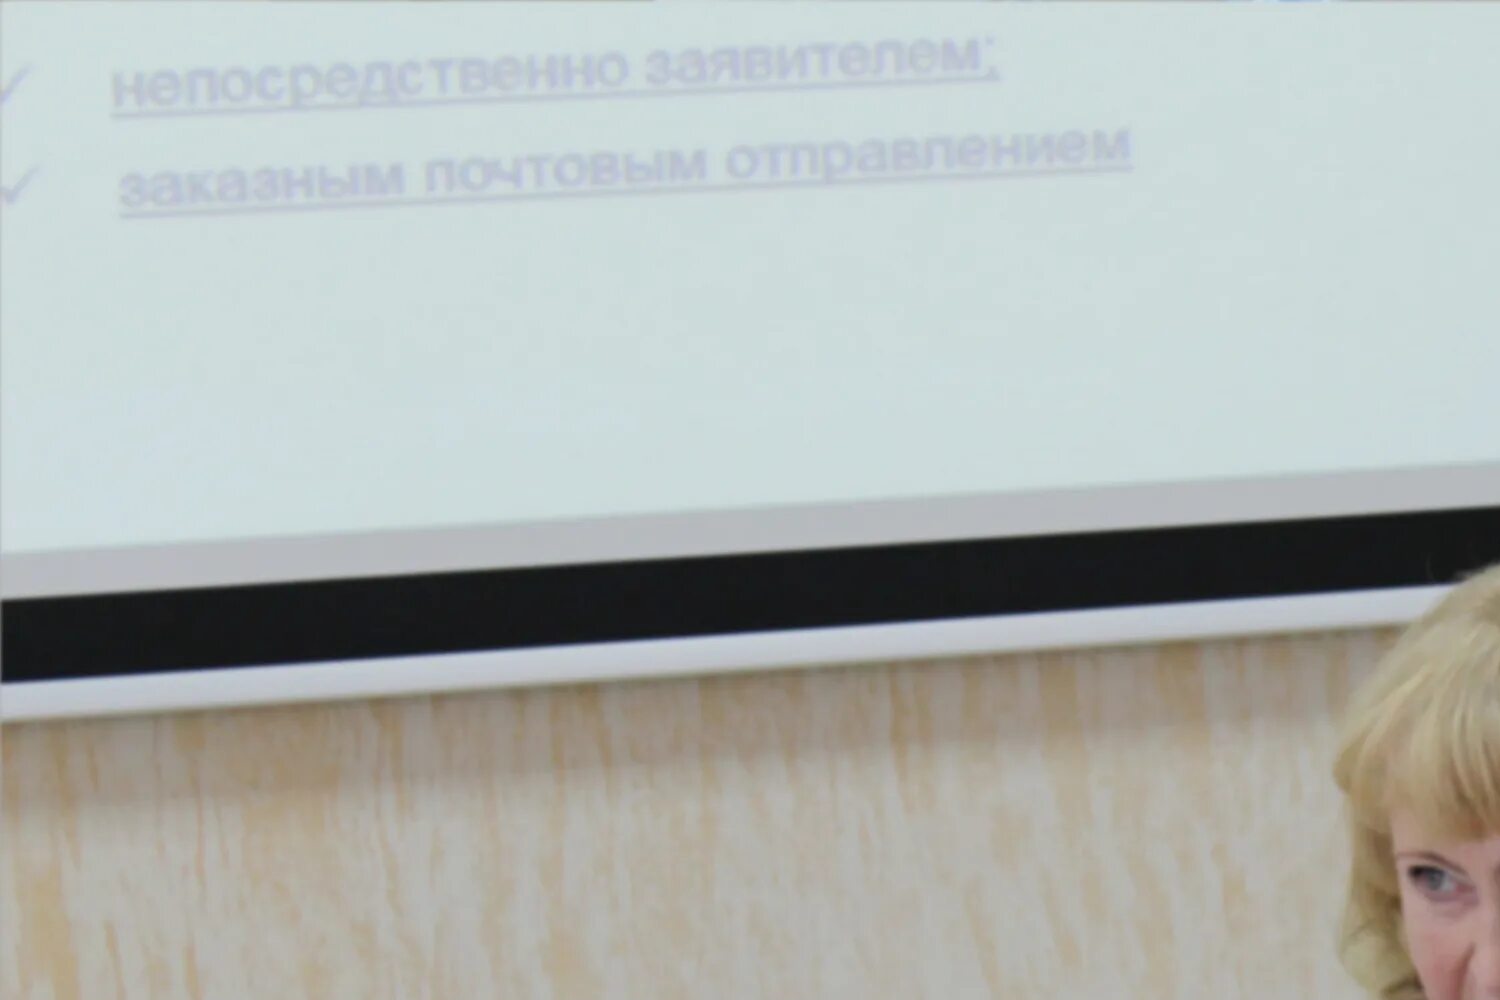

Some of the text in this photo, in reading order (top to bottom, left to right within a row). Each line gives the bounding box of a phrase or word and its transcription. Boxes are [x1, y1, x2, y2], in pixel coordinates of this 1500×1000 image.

[111, 33, 1000, 110] непосредственно заявителем;
[119, 125, 1133, 209] заказным почтовым отправлением
